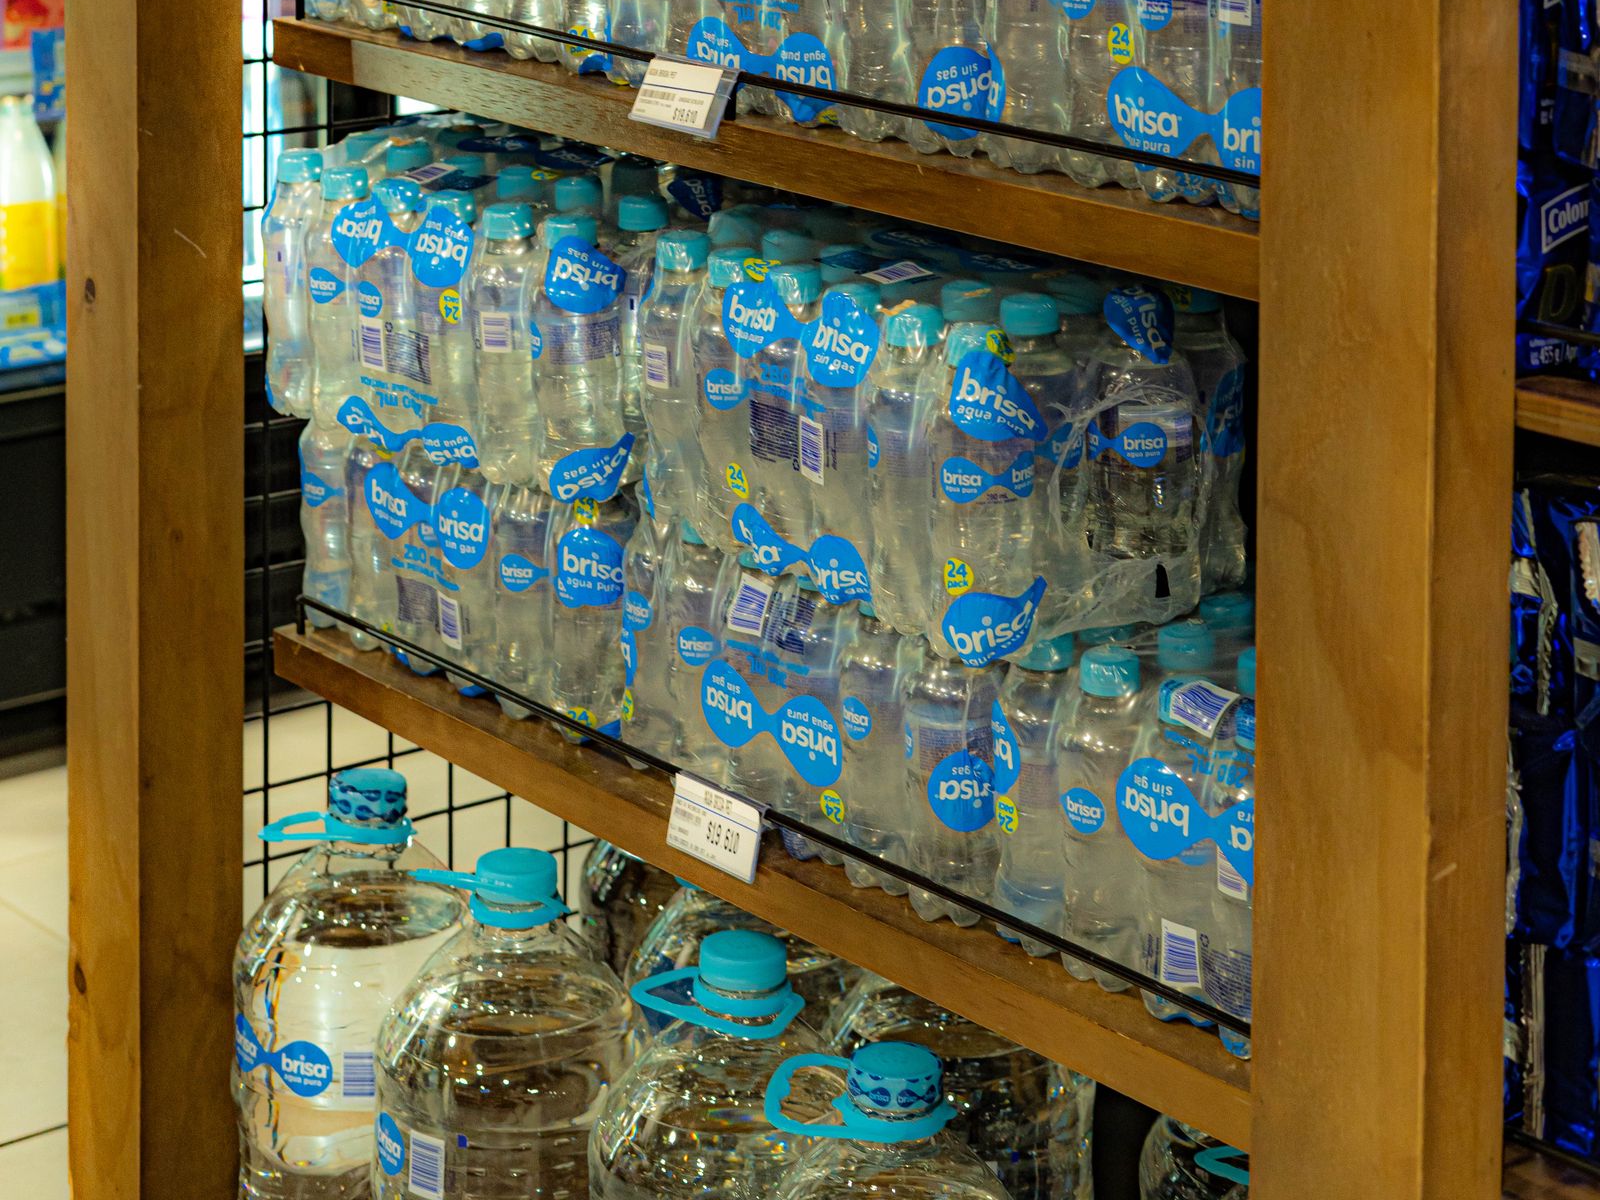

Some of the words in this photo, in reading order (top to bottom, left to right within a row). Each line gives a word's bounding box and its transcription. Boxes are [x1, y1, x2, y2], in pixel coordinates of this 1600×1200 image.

[1110, 27, 1130, 46] 24
[803, 48, 826, 62] agua
[936, 68, 958, 82] gas
[961, 62, 979, 77] sin
[1114, 94, 1180, 138] brisa
[1142, 138, 1171, 154] pura
[1234, 156, 1255, 170] sin
[341, 217, 383, 245] brisa
[415, 232, 469, 267] brisa
[567, 245, 589, 260] gas
[553, 258, 618, 291] brisa
[443, 304, 460, 321] 24
[729, 294, 777, 333] brisa
[1127, 316, 1144, 347] pura
[812, 318, 871, 366] brisa
[813, 353, 830, 364] sin
[706, 378, 742, 395] brisa
[959, 366, 1037, 432] brisa
[956, 403, 993, 422] agua
[1122, 432, 1164, 451] brisa
[728, 466, 745, 484] 24
[942, 467, 982, 487] brisa
[370, 477, 408, 519] brisa
[438, 509, 484, 543] brisa
[459, 541, 476, 555] gas
[501, 563, 533, 579] brisa
[947, 560, 967, 579] 24
[566, 577, 593, 590] agua
[947, 579, 969, 589] pack
[948, 599, 1033, 655] brisa
[678, 636, 713, 650] brisa
[706, 685, 753, 729] brisa
[786, 708, 809, 723] pura
[811, 715, 834, 731] agua
[843, 709, 869, 727] brisa
[781, 720, 837, 766] brisa
[937, 779, 996, 809] risa
[1152, 781, 1173, 797] sin
[820, 803, 842, 822] 24
[1066, 796, 1102, 818] brisa
[1124, 786, 1190, 837] brisa
[281, 1054, 329, 1078] brisa
